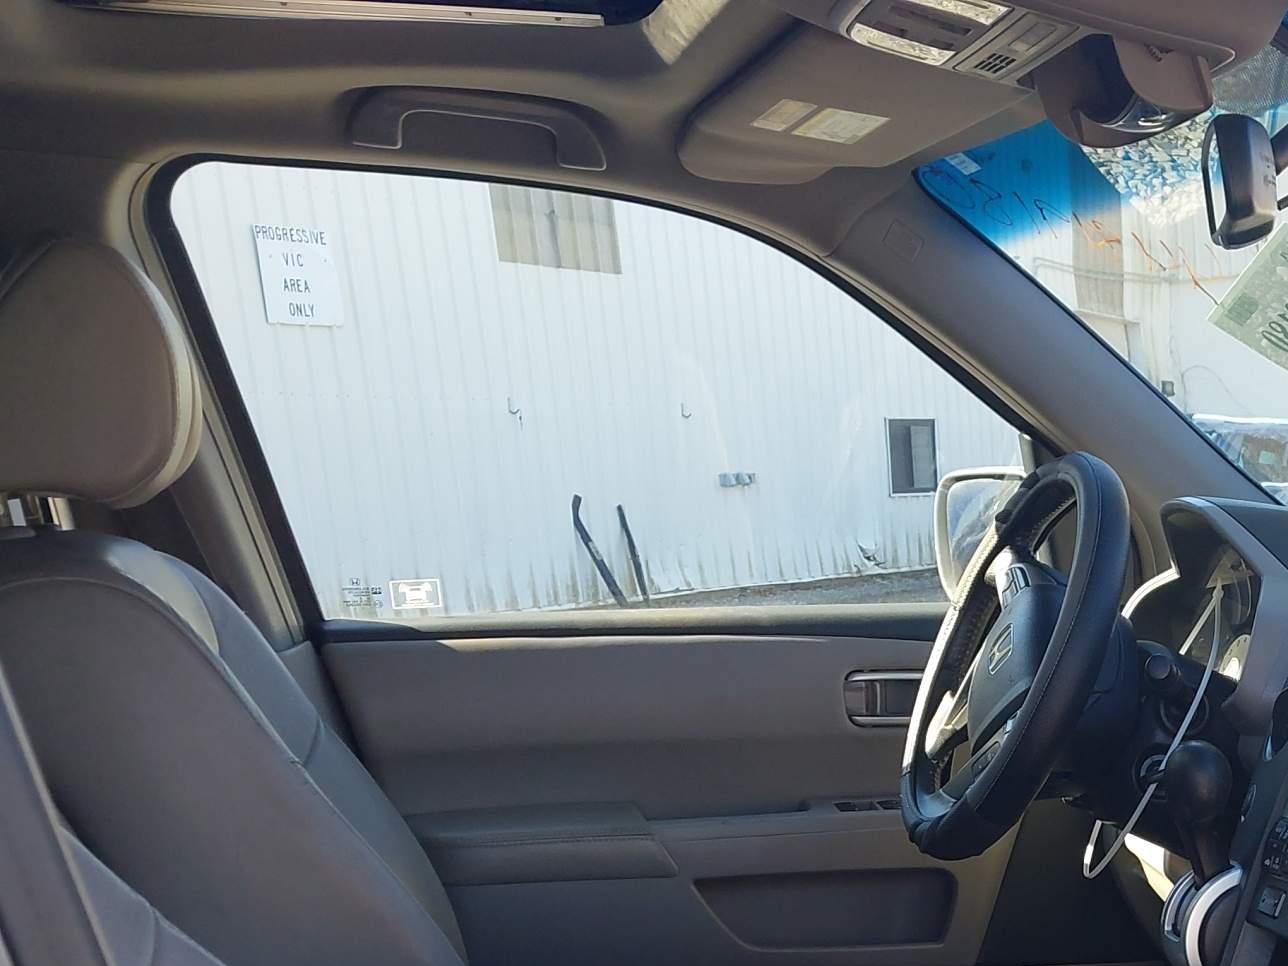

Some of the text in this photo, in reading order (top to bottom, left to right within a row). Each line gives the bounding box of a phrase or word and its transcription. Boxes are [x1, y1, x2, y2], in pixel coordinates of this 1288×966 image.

[255, 225, 326, 245] PROGRESSIVE
[283, 253, 304, 267] VIC
[284, 278, 311, 293] AREA
[289, 302, 315, 317] ONLY
